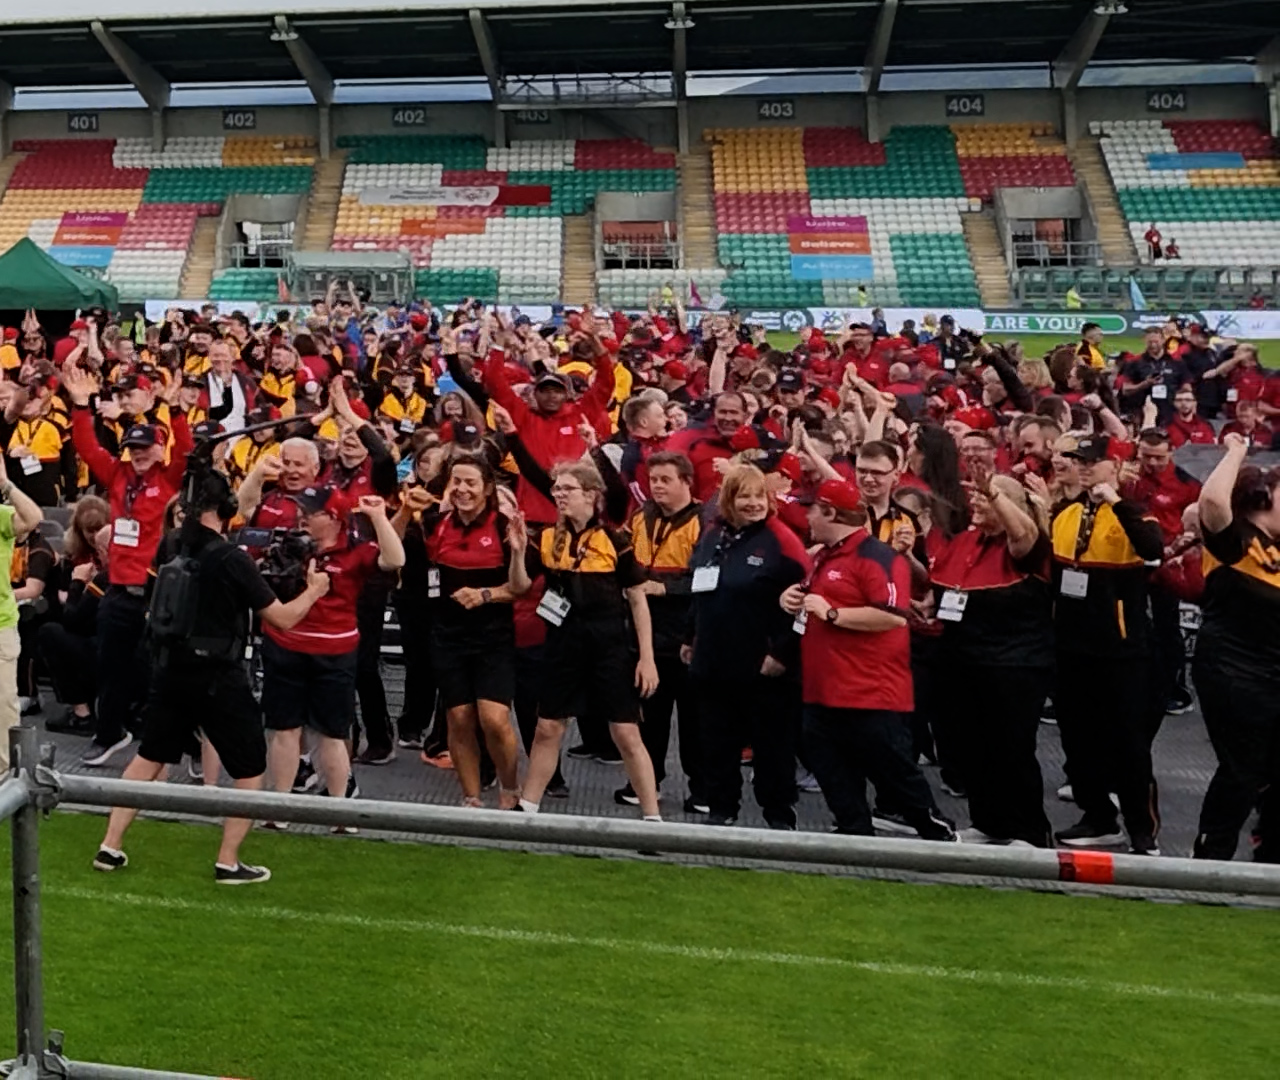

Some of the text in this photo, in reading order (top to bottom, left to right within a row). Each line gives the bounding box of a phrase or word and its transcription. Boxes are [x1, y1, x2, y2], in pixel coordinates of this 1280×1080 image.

[948, 98, 982, 113] 404
[1149, 94, 1185, 109] 404
[393, 109, 425, 124] 402
[760, 102, 793, 117] 403
[70, 116, 97, 130] 401
[224, 113, 254, 127] 402
[991, 316, 1030, 329] ARE
